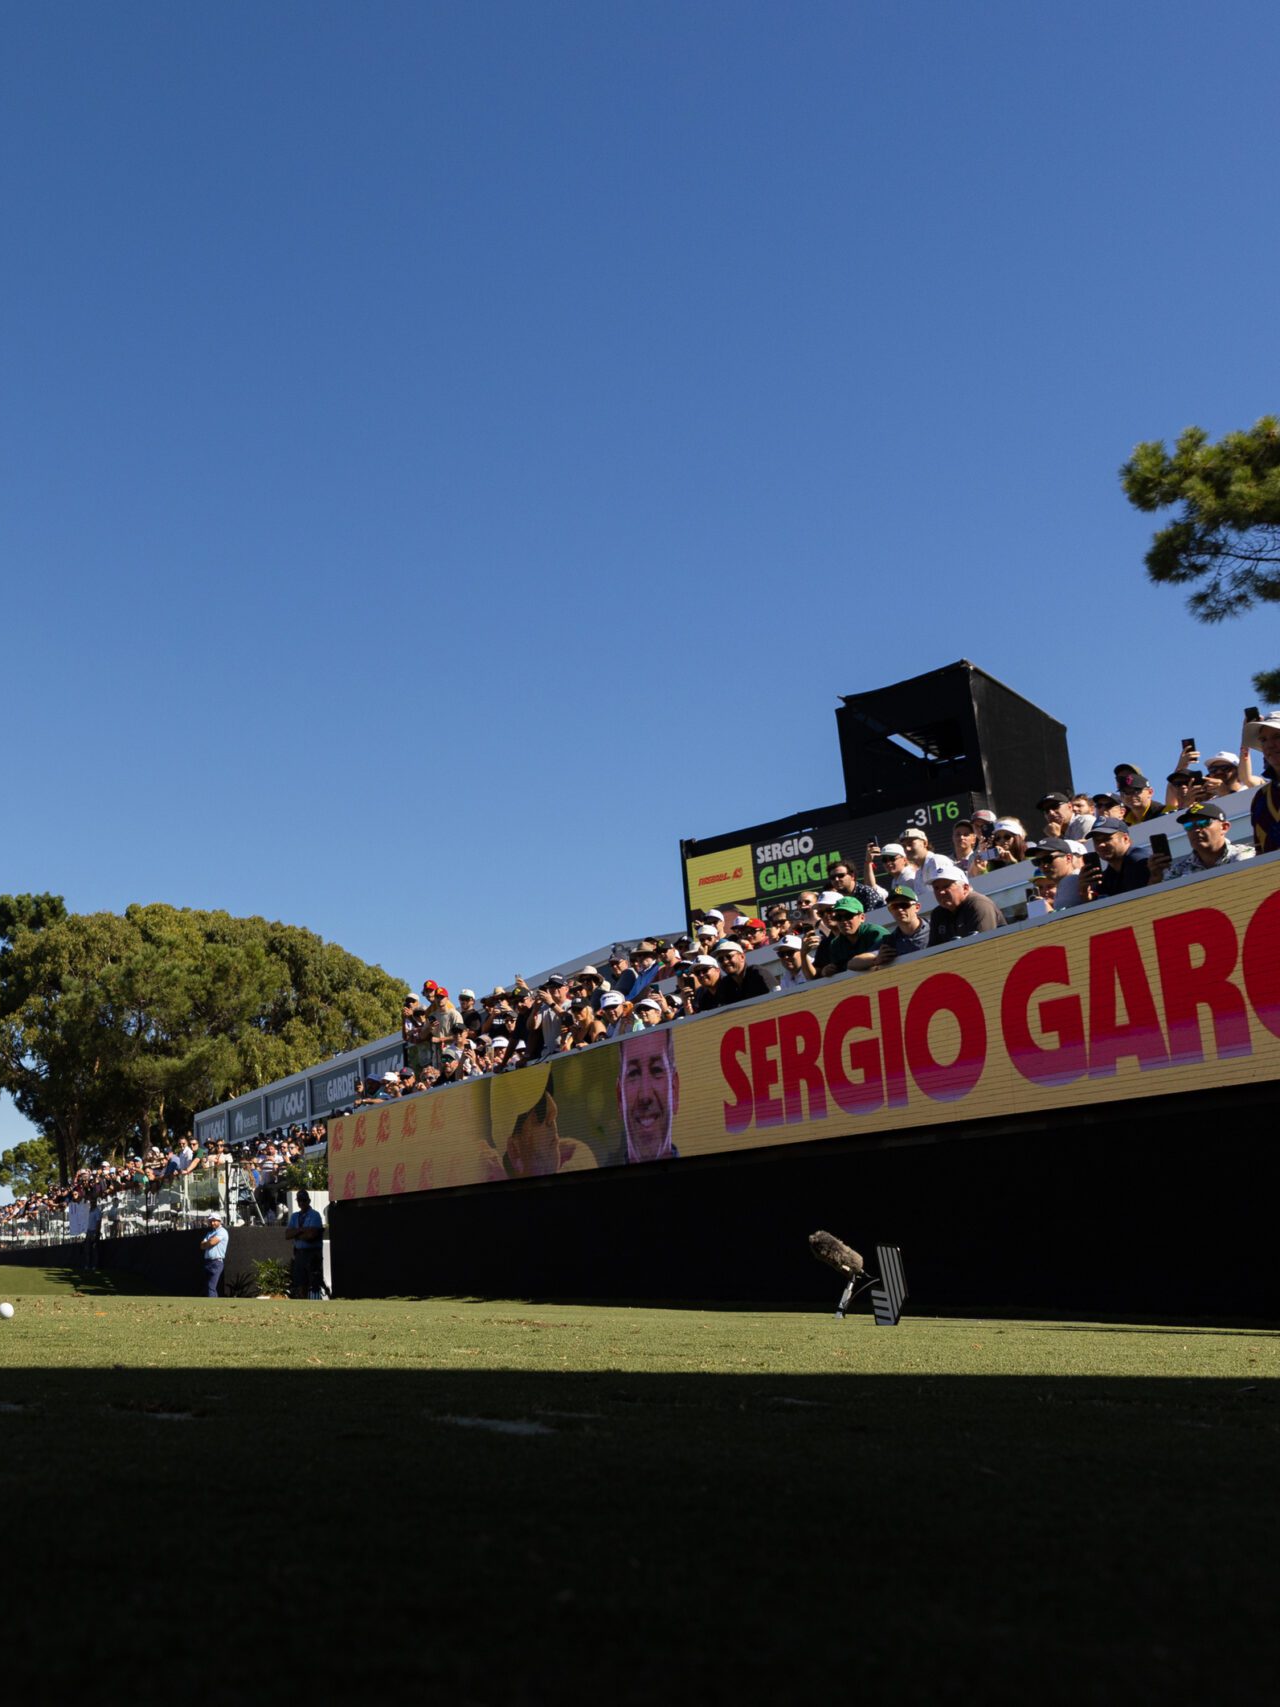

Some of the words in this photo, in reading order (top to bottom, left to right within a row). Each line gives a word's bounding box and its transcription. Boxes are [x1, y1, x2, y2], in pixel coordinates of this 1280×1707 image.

[907, 808, 927, 826] -3
[931, 801, 959, 821] T6
[756, 836, 814, 864] SERGIO
[719, 972, 987, 1134] SERGIO
[284, 1089, 304, 1117] GOLF
